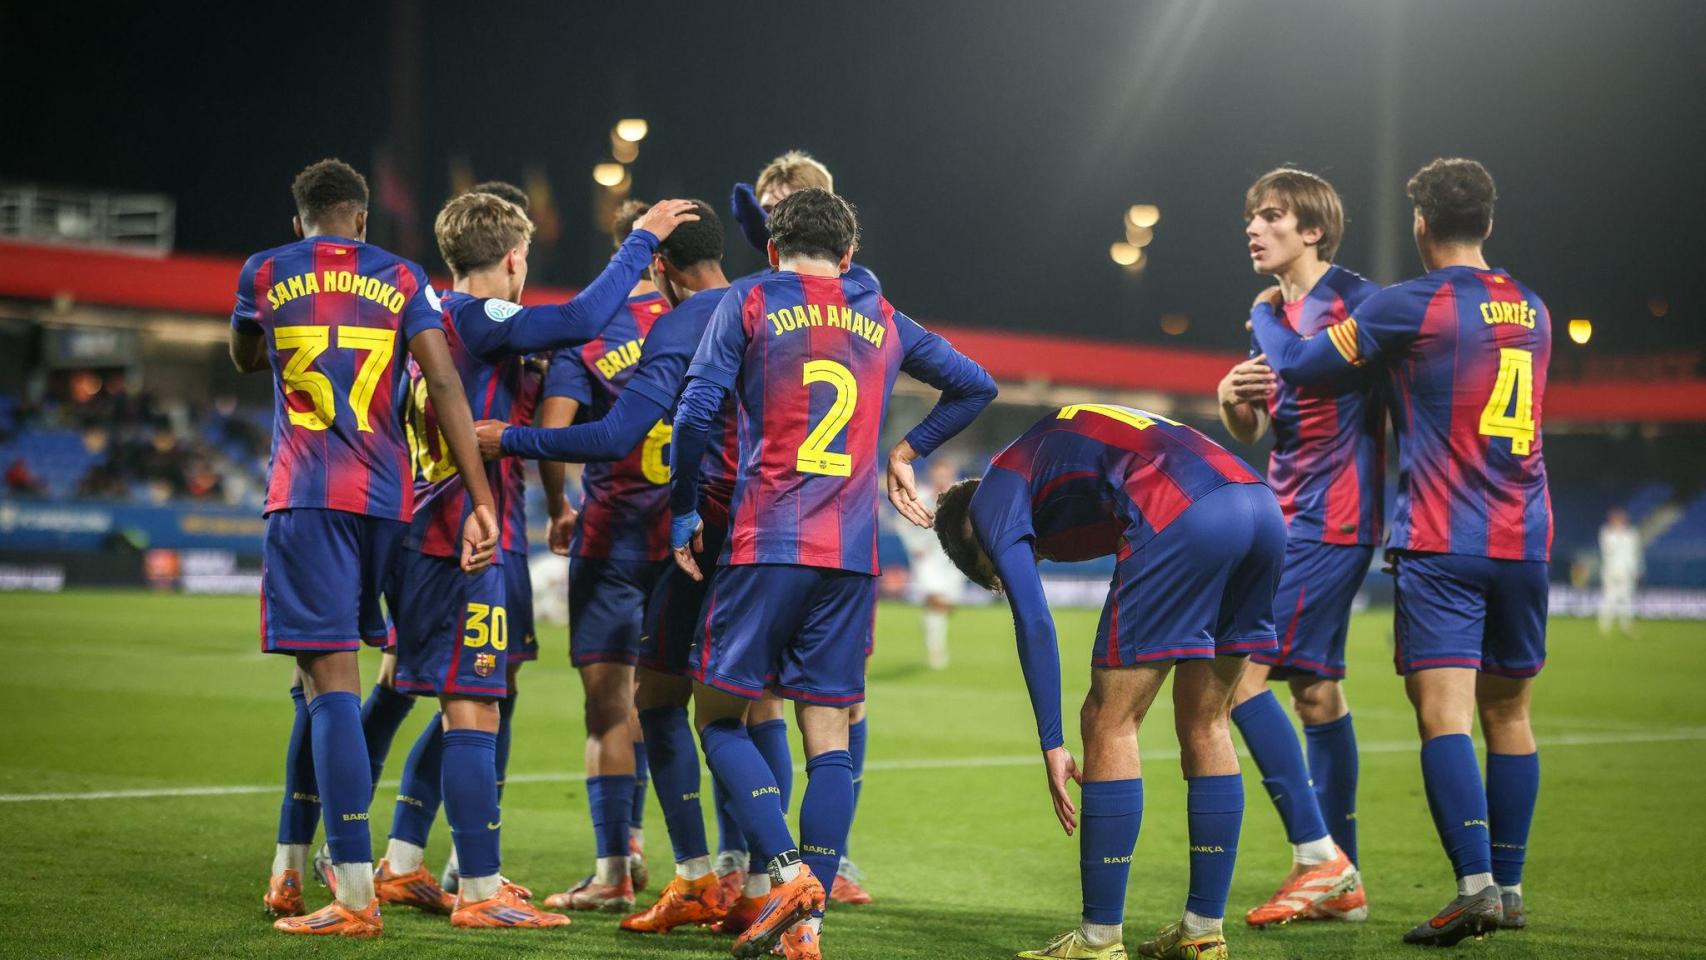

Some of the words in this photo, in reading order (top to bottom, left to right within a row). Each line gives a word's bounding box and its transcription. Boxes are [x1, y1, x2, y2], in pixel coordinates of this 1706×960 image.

[267, 272, 320, 310] SAMA
[323, 271, 406, 314] NOMOKO
[1480, 300, 1536, 329] CORTÉS
[766, 304, 823, 336] JOAN
[826, 304, 886, 349] ANAYA
[274, 325, 397, 434] 37
[595, 338, 645, 380] BRIA
[796, 359, 858, 477] 2
[1478, 347, 1536, 456] 4
[463, 602, 508, 651] 30
